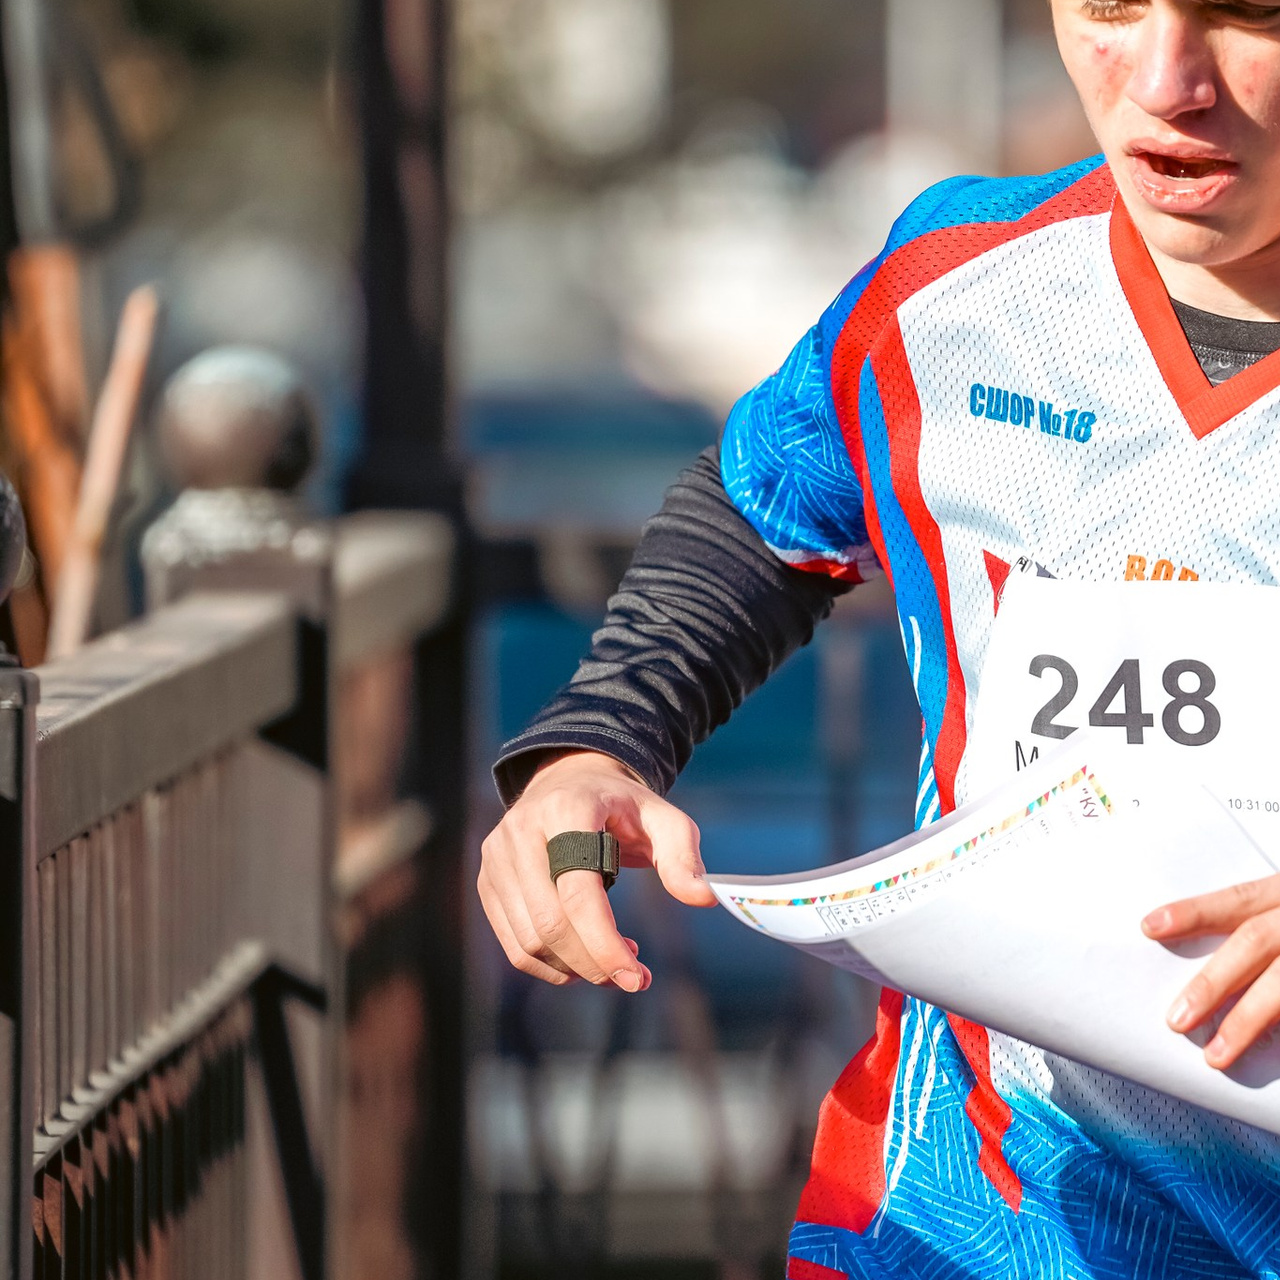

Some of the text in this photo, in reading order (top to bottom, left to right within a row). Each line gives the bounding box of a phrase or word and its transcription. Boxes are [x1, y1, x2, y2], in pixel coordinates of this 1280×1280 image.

[969, 382, 1036, 429] СШОР
[1028, 654, 1221, 746] 248
[1228, 798, 1280, 813] 10:31:00
